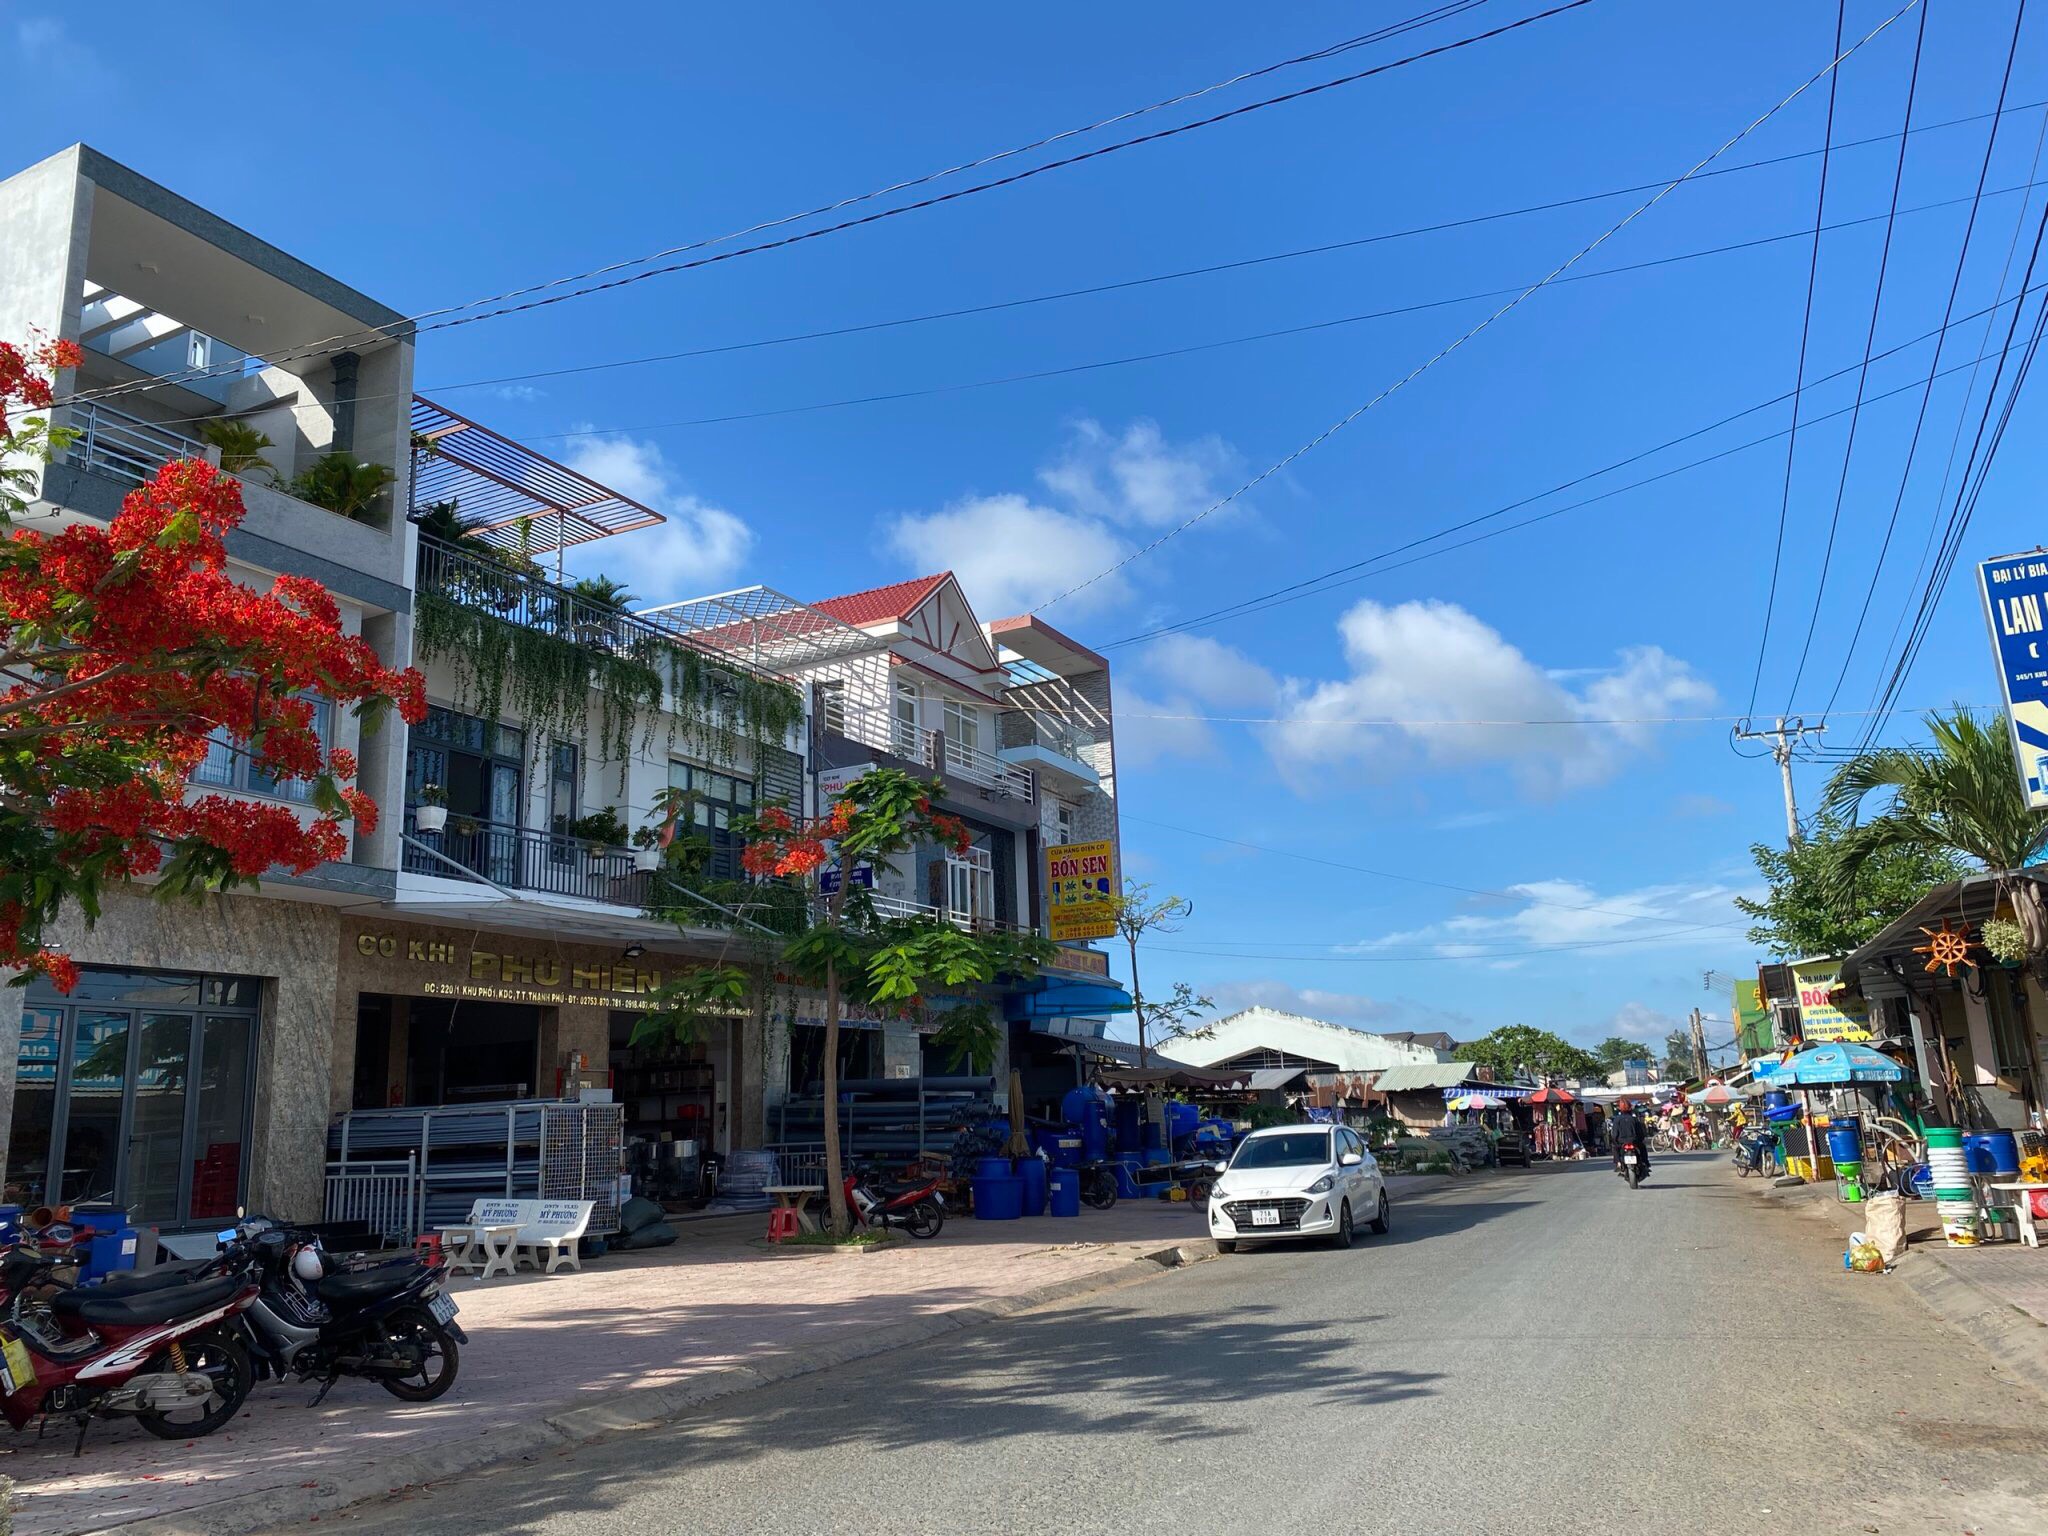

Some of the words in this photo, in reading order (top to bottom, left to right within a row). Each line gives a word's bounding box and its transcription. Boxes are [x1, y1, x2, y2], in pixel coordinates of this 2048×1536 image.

[1992, 568, 2011, 584] ĐẠI
[2013, 563, 2026, 580] LÝ
[1999, 594, 2043, 636] LAN
[1050, 854, 1079, 878] BỐN
[1082, 855, 1107, 874] SEN
[408, 937, 455, 964] KHÍ
[470, 950, 561, 987] PHÚ
[572, 960, 661, 994] HIỀN
[440, 984, 460, 995] 220/1
[462, 986, 477, 996] KHU
[481, 1208, 492, 1217] MỸ
[540, 1210, 551, 1219] MỸ
